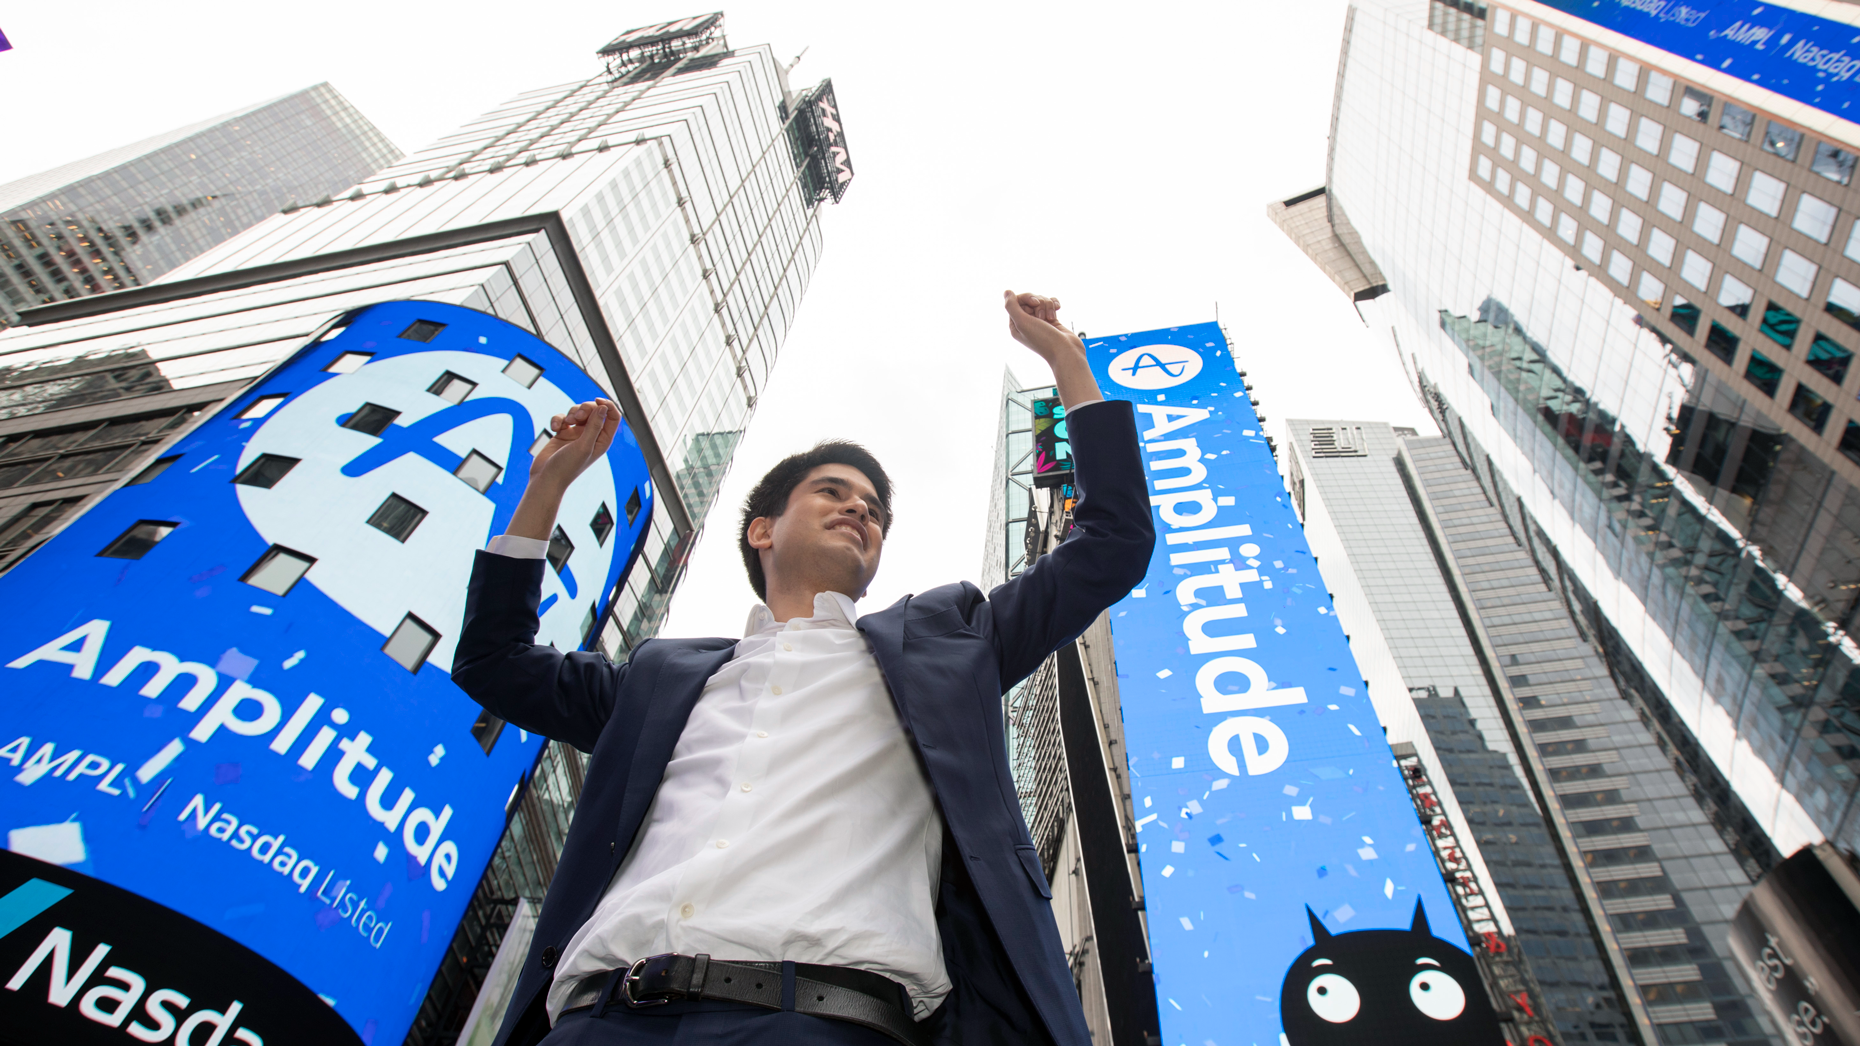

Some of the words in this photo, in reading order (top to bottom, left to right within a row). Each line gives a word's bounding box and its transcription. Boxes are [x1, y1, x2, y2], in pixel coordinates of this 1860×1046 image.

[1719, 20, 1776, 50] AMPL
[1783, 38, 1860, 82] Nasdaq
[1137, 404, 1308, 776] Amplitude
[0, 736, 127, 797] AMPL
[177, 792, 320, 893] Nasdaq
[316, 869, 393, 949] Listed
[4, 619, 459, 892] Amplitude
